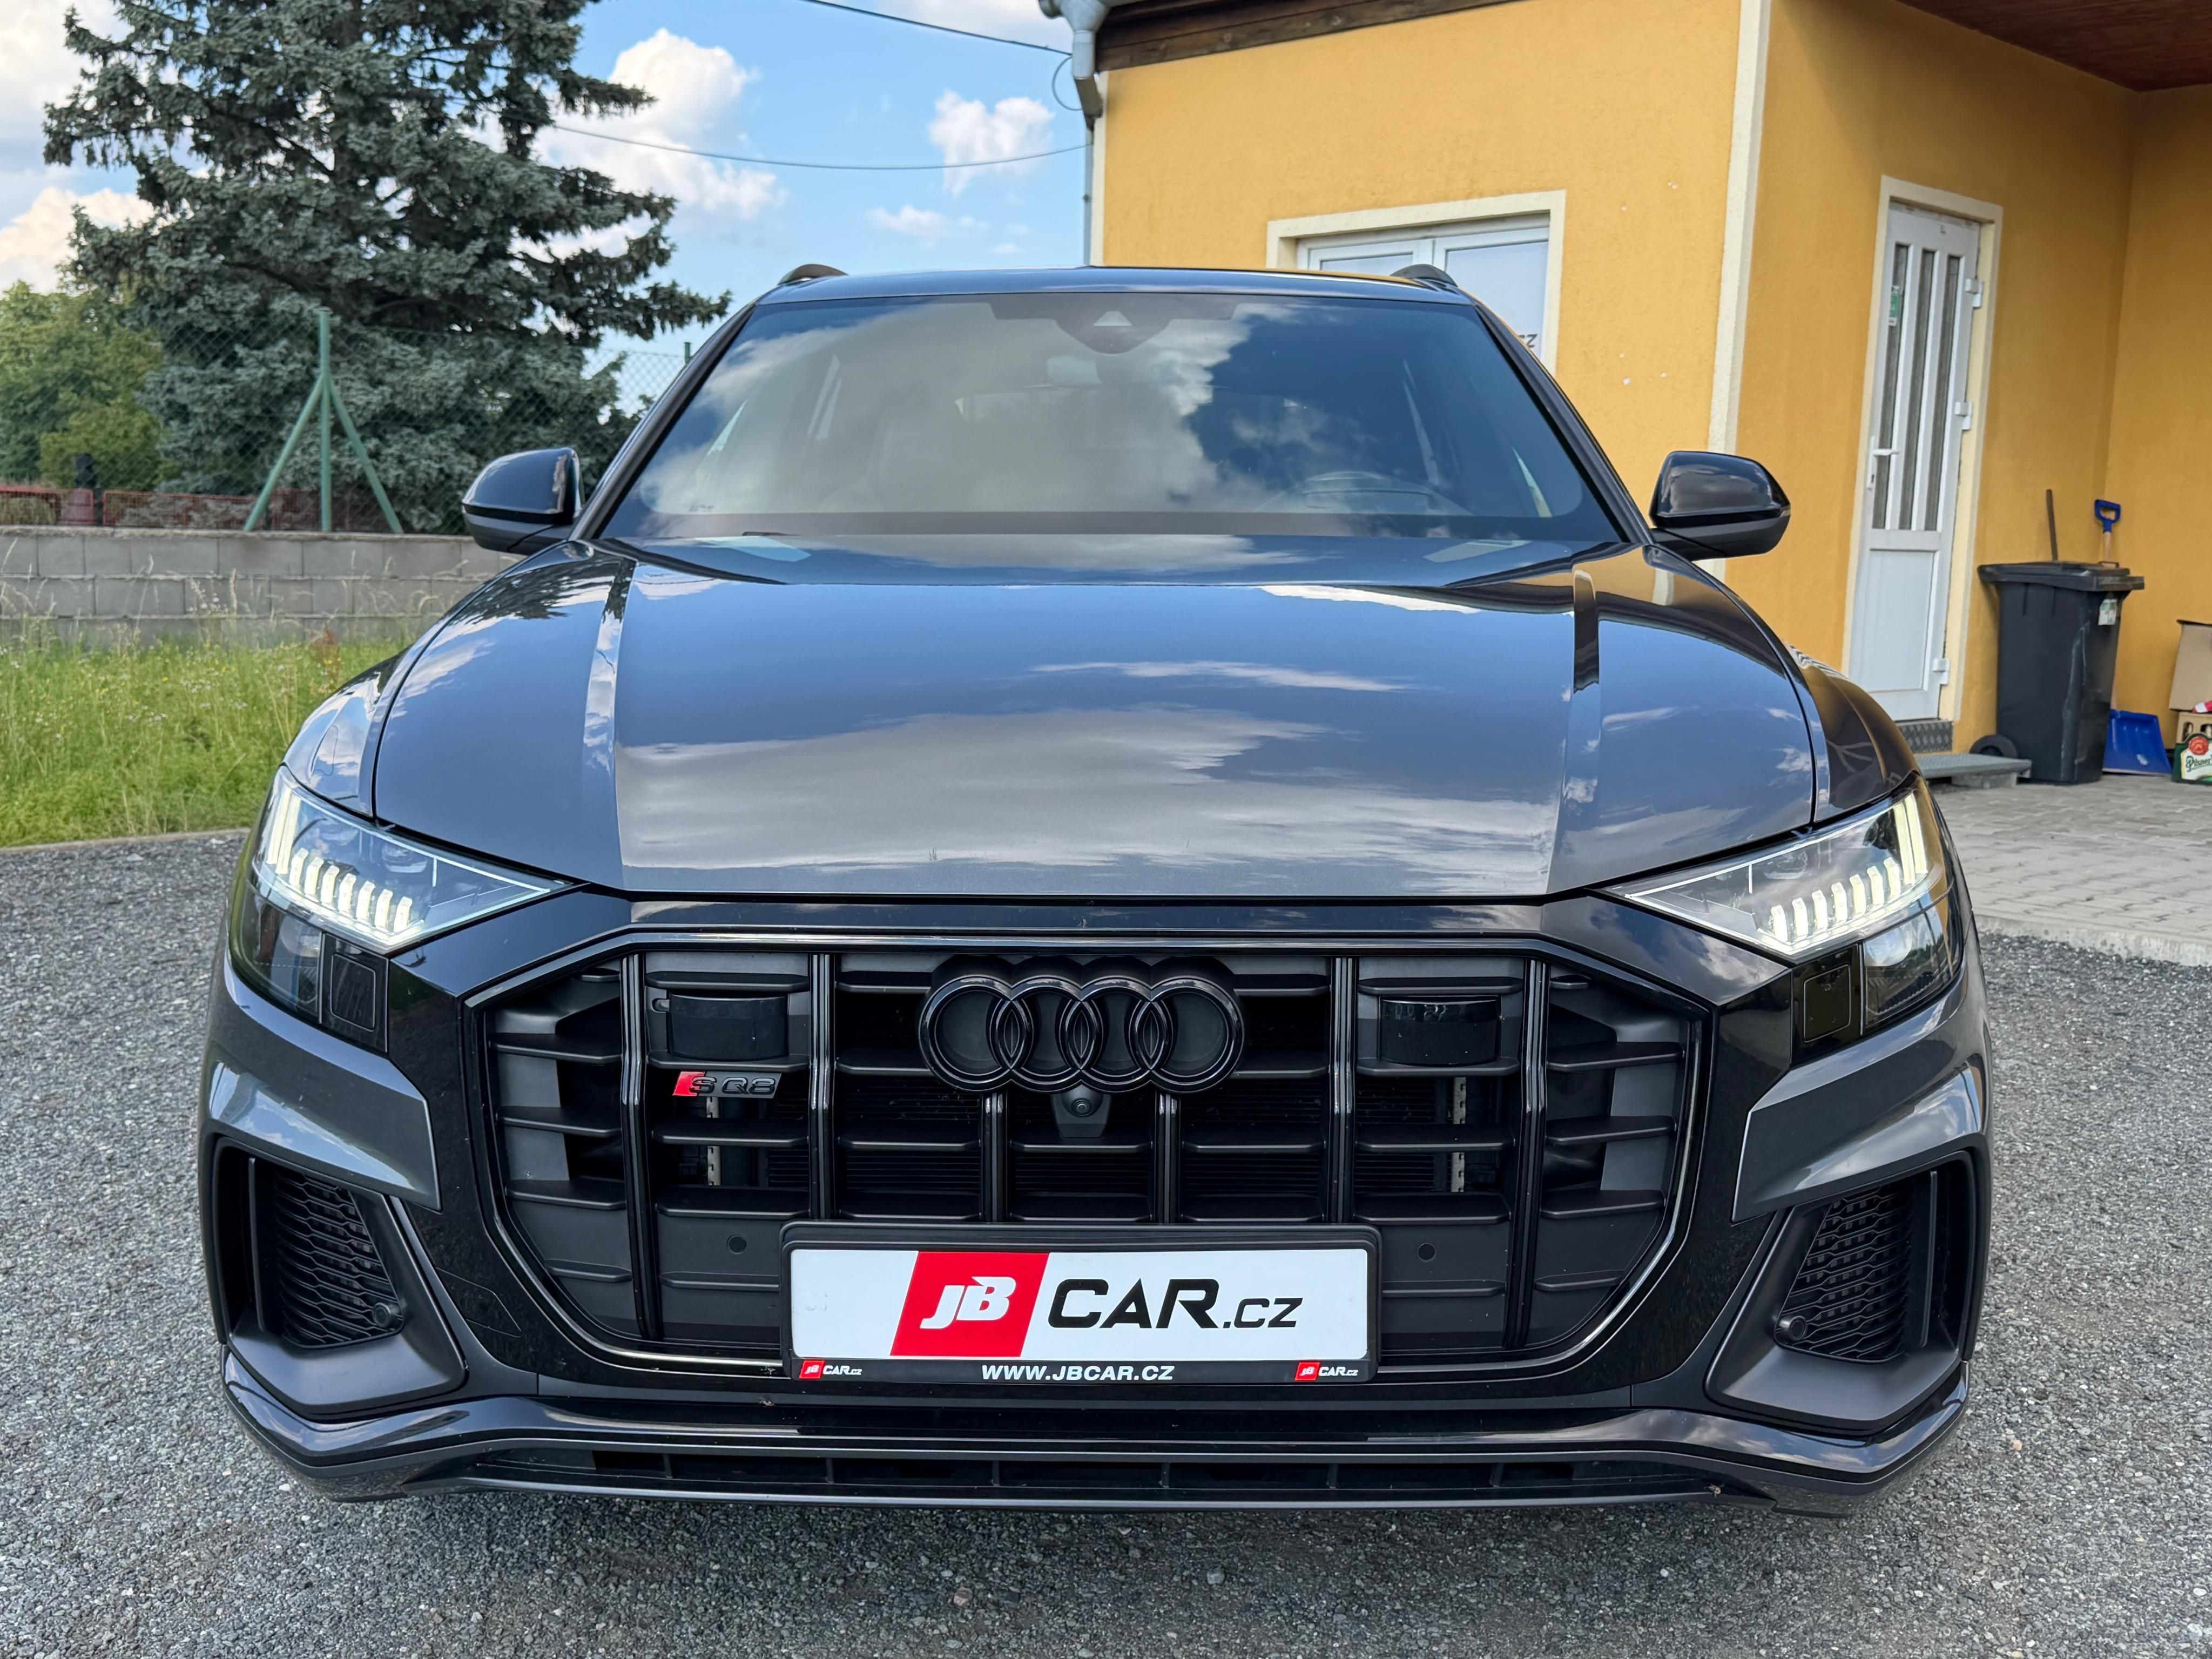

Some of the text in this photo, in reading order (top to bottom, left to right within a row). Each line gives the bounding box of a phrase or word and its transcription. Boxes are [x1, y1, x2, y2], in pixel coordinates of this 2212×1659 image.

[1517, 334, 1537, 348] Z
[689, 1076, 776, 1095] SQ8
[982, 1365, 1175, 1381] WWW.JBCAR.CZ
